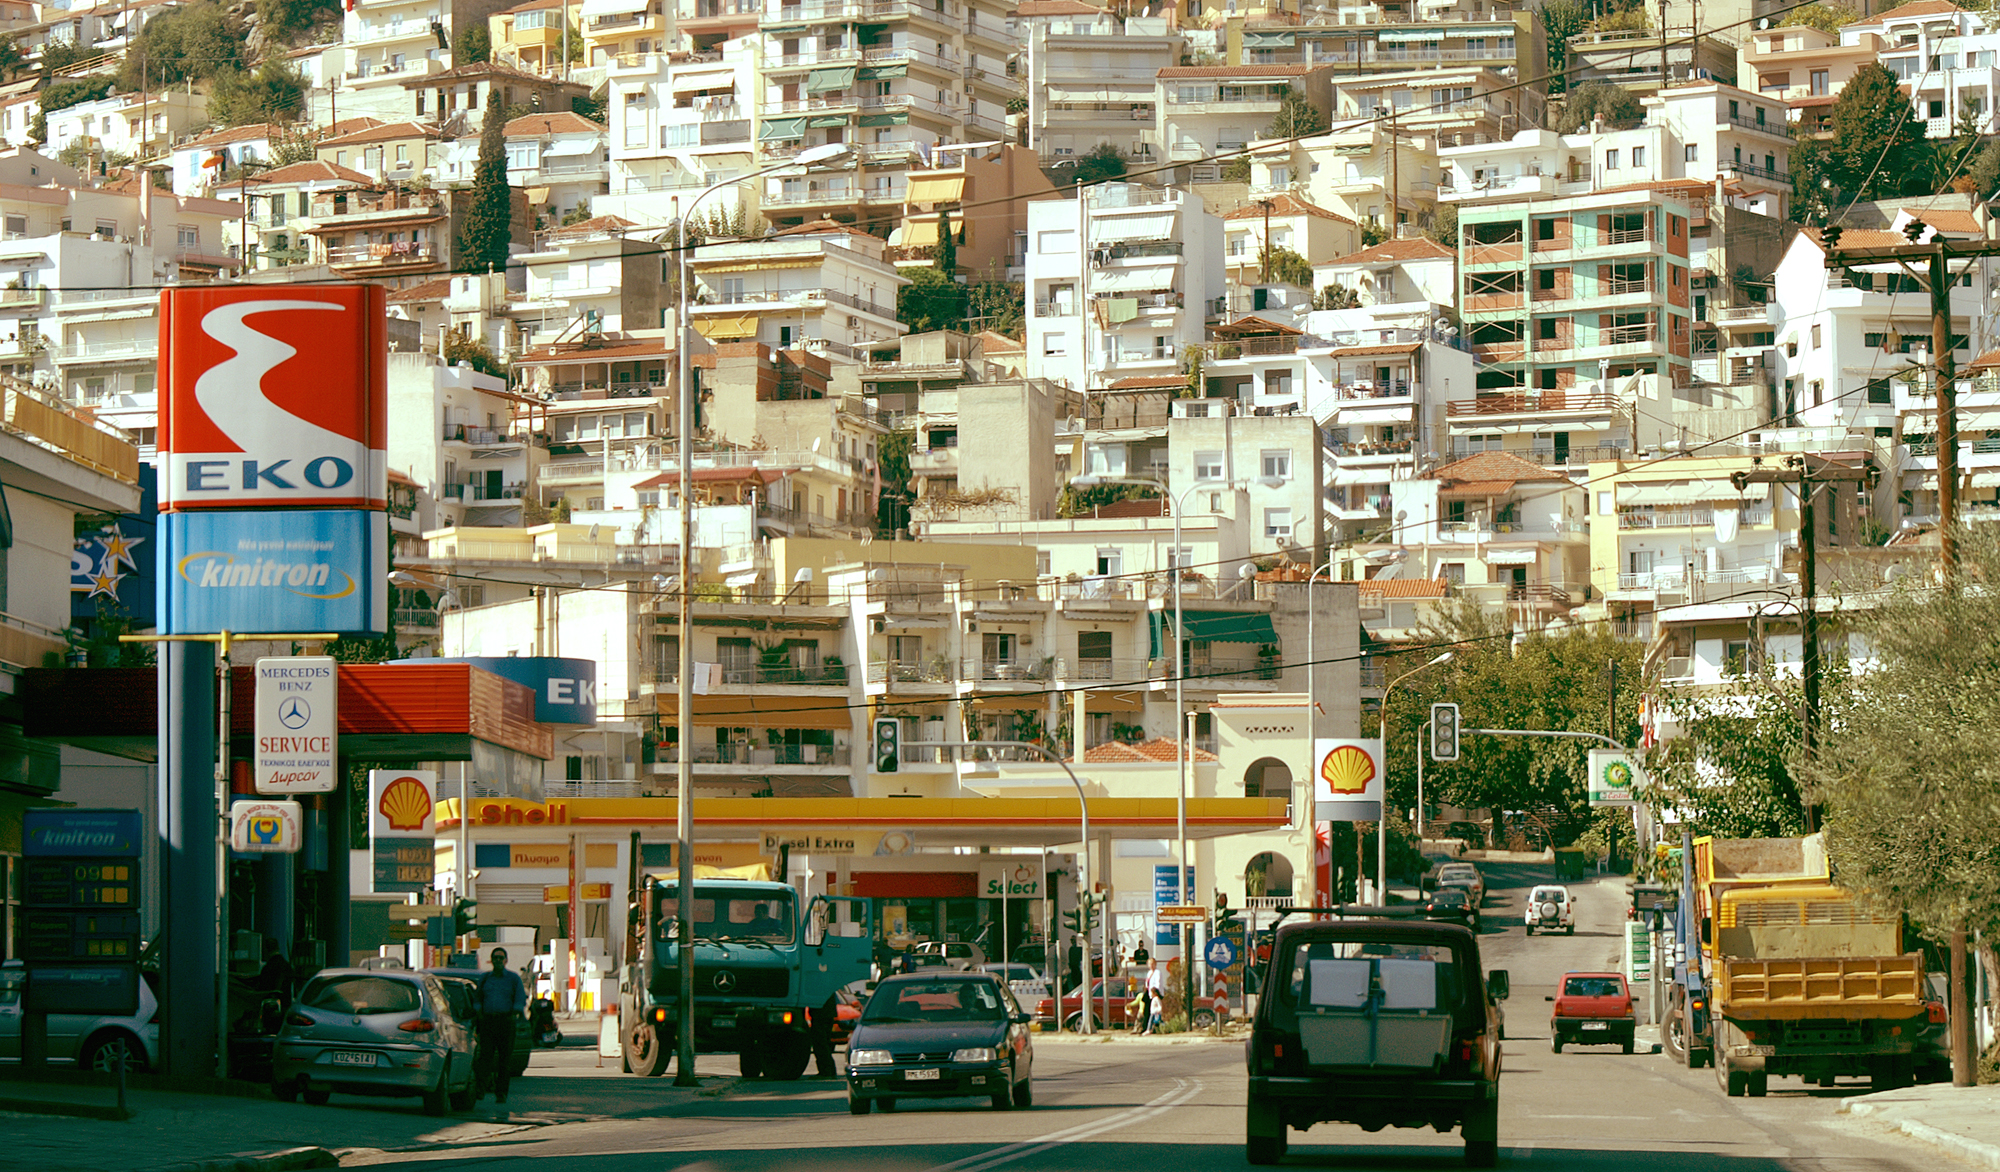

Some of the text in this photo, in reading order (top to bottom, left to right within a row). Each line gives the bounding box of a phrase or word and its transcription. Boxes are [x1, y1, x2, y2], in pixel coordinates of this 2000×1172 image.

[186, 456, 354, 491] EKO
[199, 557, 330, 588] kinitron
[261, 667, 330, 678] MERCEDES
[279, 681, 312, 692] BENZ
[260, 736, 331, 753] SERVICE
[260, 759, 331, 767] ΤΕΧΝΙΚΟΣ ΕΛΕΓΧΟΣ
[479, 803, 567, 825] Shell
[43, 829, 116, 846] kinitron
[815, 835, 855, 849] Extra
[987, 879, 1038, 895] Select
